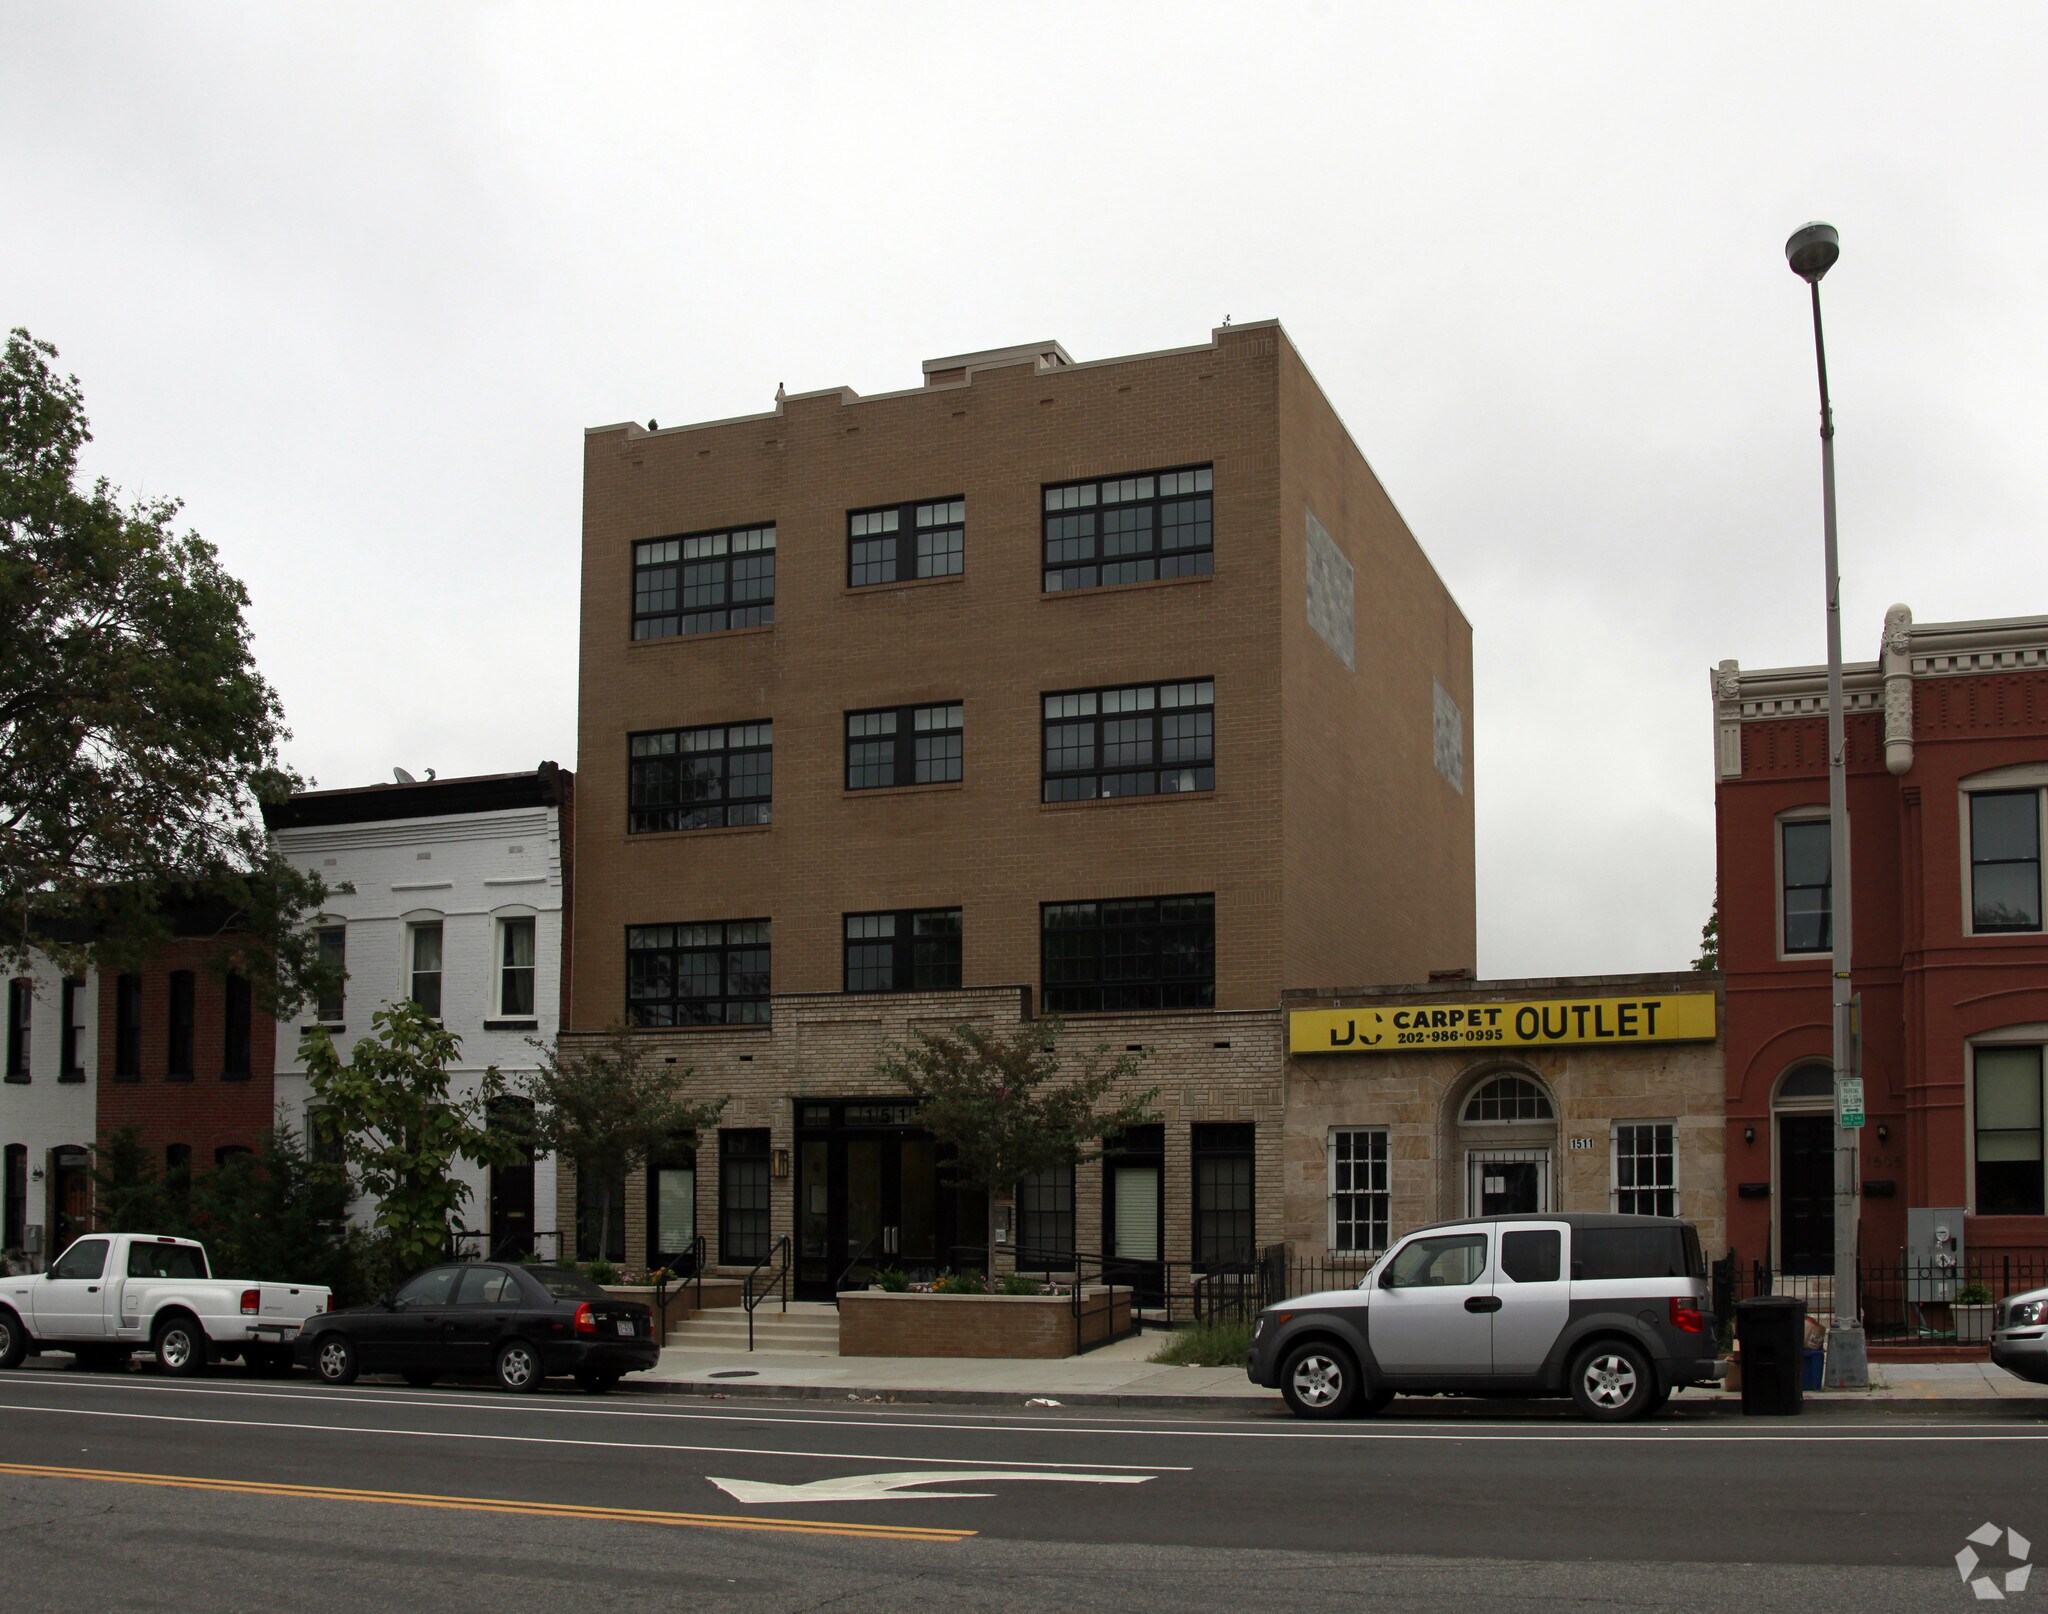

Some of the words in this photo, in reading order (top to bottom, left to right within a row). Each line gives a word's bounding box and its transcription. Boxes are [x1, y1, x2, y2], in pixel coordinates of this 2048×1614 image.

[1393, 1008, 1502, 1029] CARPET
[1515, 1002, 1661, 1040] OUTLET
[1572, 1139, 1593, 1149] 1511
